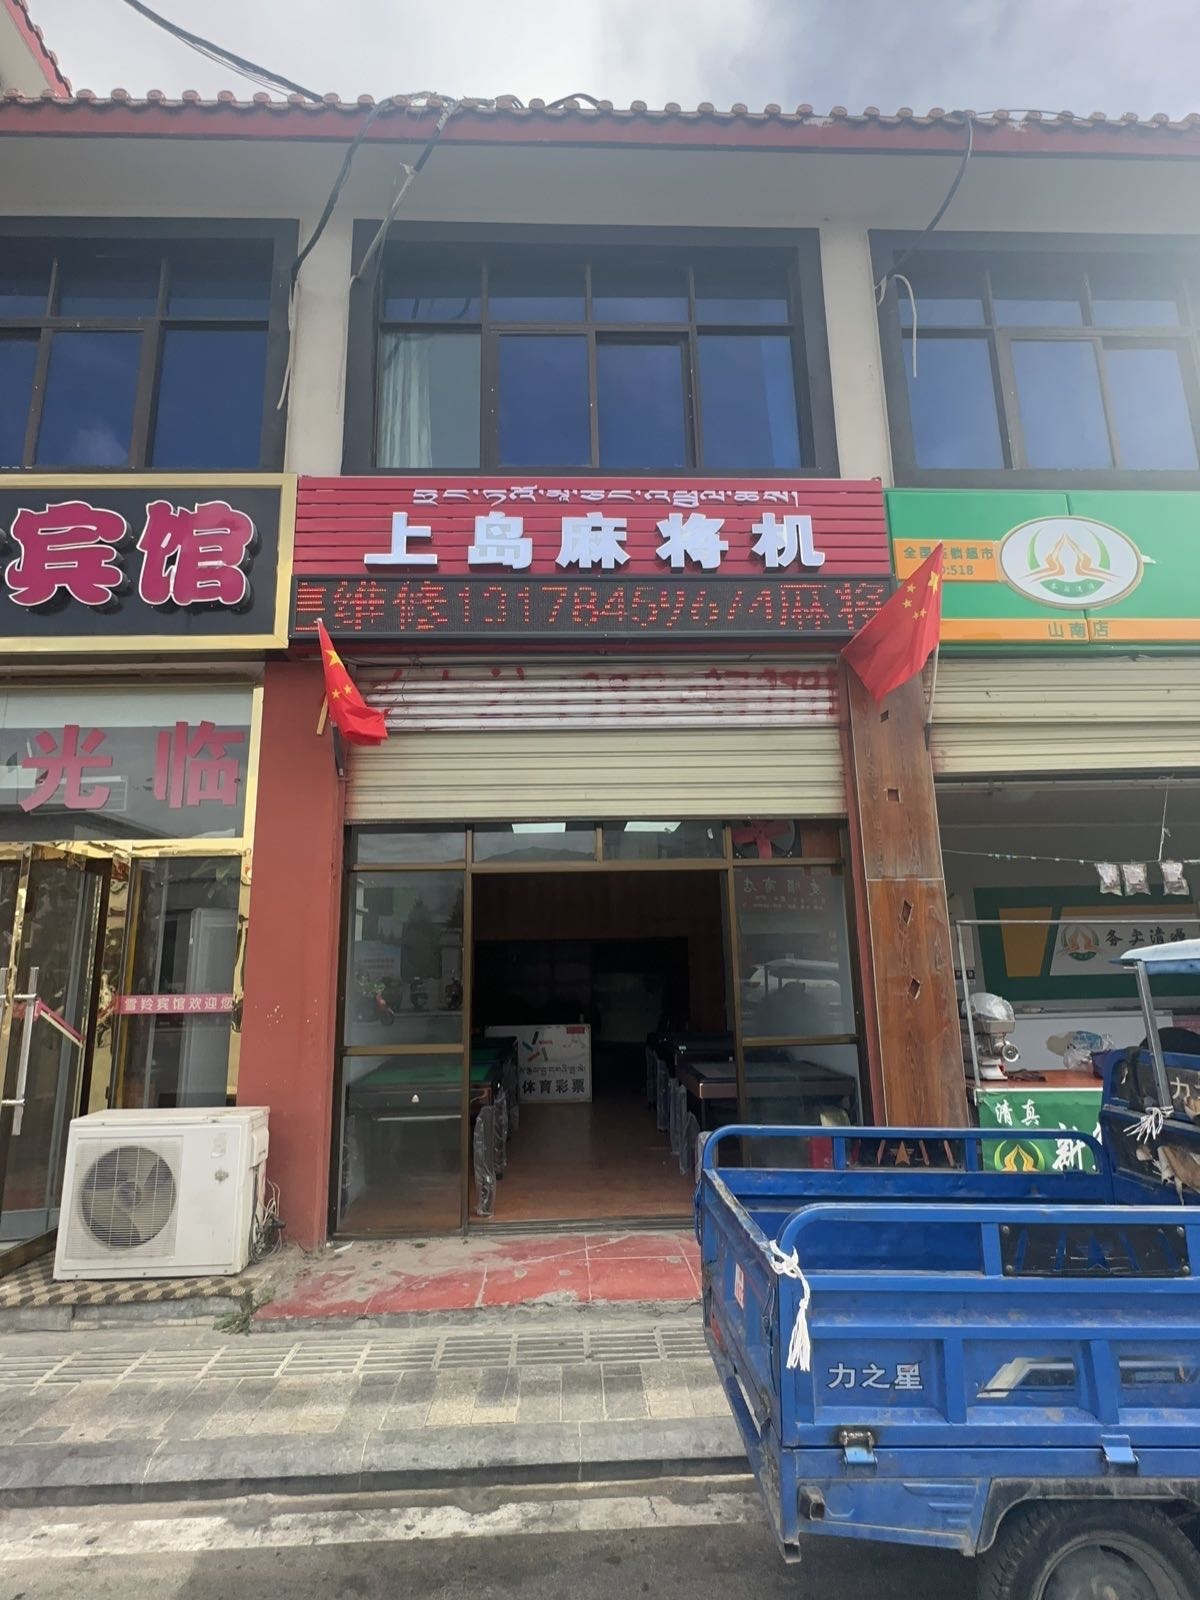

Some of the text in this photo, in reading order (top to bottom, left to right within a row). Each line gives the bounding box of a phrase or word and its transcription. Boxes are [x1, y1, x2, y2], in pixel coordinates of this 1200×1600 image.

[5, 500, 254, 606] 宾馆
[363, 510, 827, 570] 上岛麻将机
[1048, 620, 1109, 638] 山南店
[19, 719, 246, 813] 光临
[522, 1078, 584, 1094] 体育彩票
[995, 1098, 1040, 1127] 清真
[829, 1363, 923, 1390] 力之星
